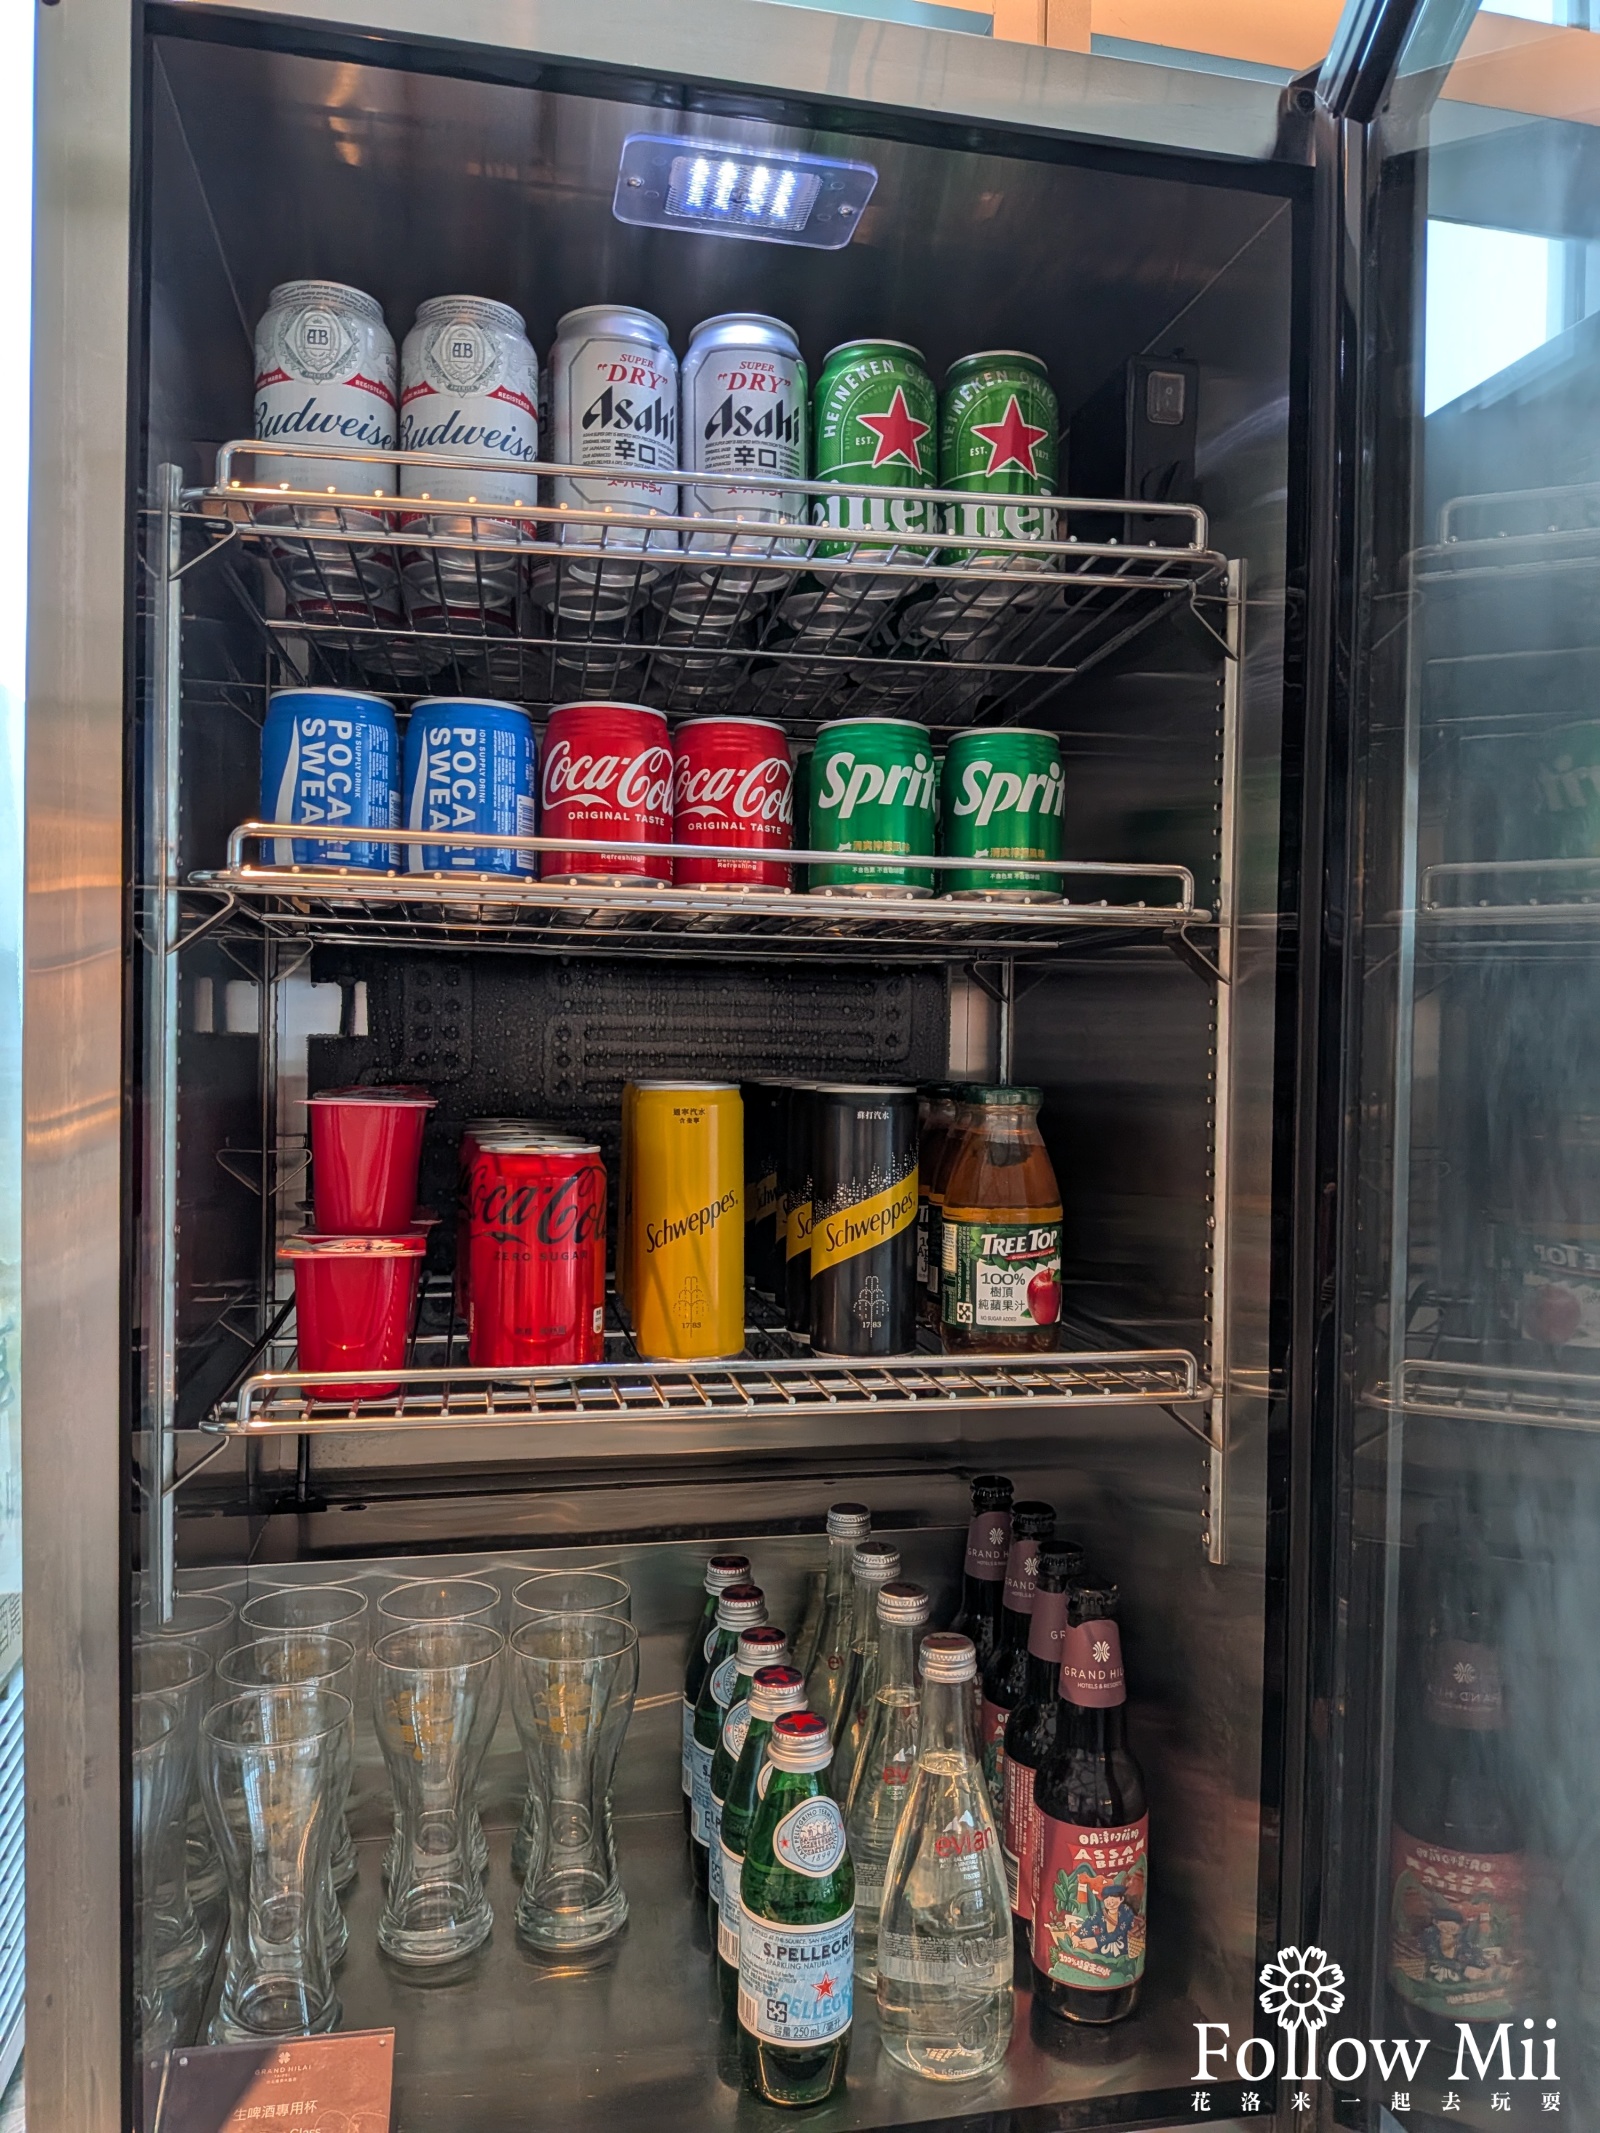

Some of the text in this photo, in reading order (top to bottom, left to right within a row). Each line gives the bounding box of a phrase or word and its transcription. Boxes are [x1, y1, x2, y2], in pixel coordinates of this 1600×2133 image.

[619, 353, 655, 369] SUPER
[739, 361, 775, 373] SUPER
[824, 360, 895, 438] HEINEKEN
[582, 385, 674, 444] Asahi
[941, 370, 1008, 450] HEINEKEN
[704, 394, 800, 447] Asahi
[856, 437, 874, 446] EST.
[614, 438, 656, 466] 辛口
[734, 445, 777, 469] 辛口
[970, 447, 987, 456] EST.
[301, 717, 327, 846] SWEA
[429, 727, 451, 852] SWEA
[568, 811, 665, 826] ORIGINAL TASTE
[688, 822, 782, 835] ORIGINAL TASTE
[600, 853, 642, 864] Refreshing
[717, 862, 757, 871] Refreshing
[856, 1110, 890, 1120] 蘇打汽水
[981, 1233, 1027, 1257] TREE
[1028, 1229, 1057, 1252] TOP
[495, 1250, 587, 1262] ZERO SUGAR
[980, 1272, 1026, 1286] 100%
[990, 1286, 1014, 1298] 樹頂
[978, 1299, 1026, 1311] 純蘋果汁
[967, 1547, 1000, 1559] GRAND
[1064, 1665, 1106, 1680] GRAND
[1077, 1682, 1098, 1690] HOTELS
[935, 1826, 994, 1857] evian
[1073, 1837, 1145, 1860] ASSAM
[1095, 1855, 1135, 1869] BEER
[765, 1957, 832, 1970] SPARKLING NATURAL
[255, 2066, 286, 2076] GRAND
[233, 2100, 319, 2121] 生啤酒專用杯
